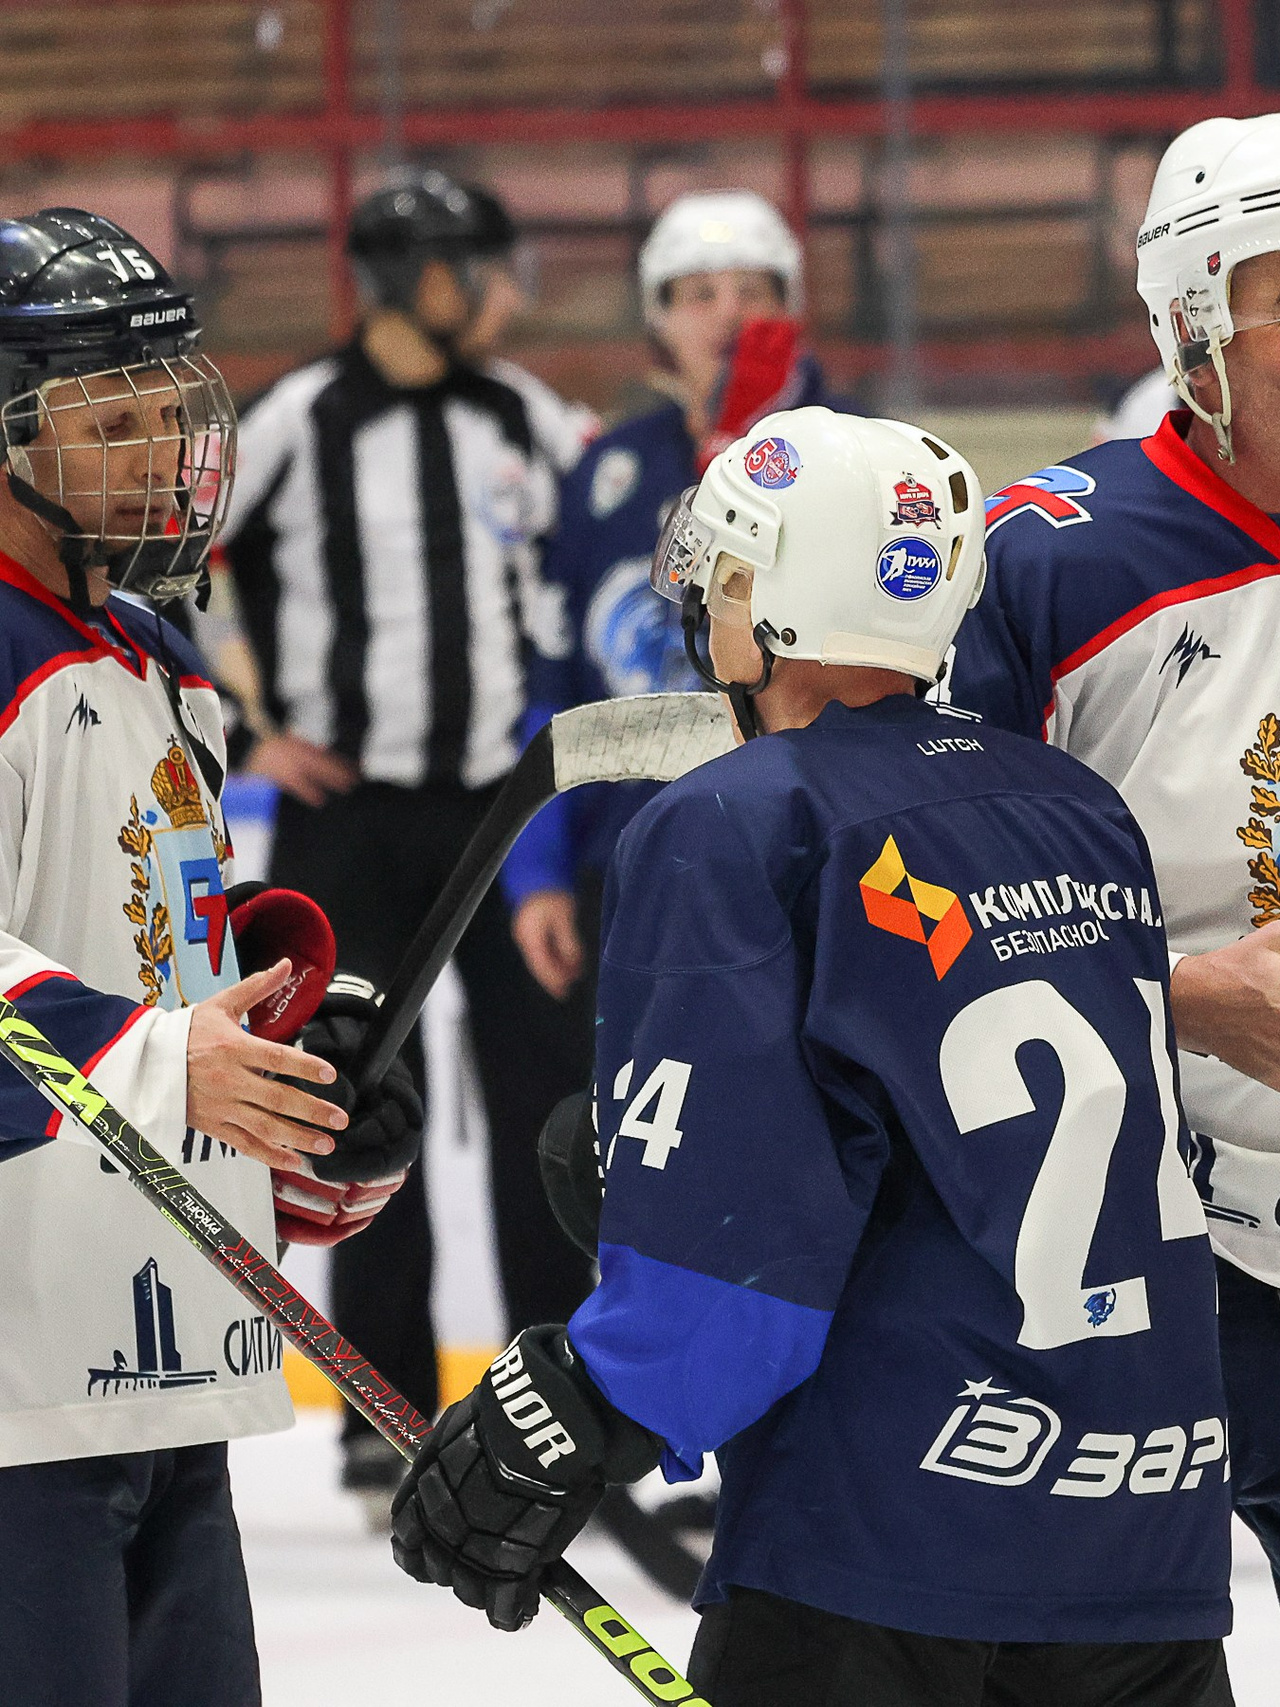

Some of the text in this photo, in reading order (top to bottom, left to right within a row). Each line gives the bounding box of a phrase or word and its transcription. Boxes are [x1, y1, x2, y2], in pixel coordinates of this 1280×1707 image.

[1138, 222, 1171, 248] BAUER
[96, 248, 155, 283] 75
[130, 307, 186, 328] BAUER
[916, 738, 985, 756] LUTCH
[183, 1192, 222, 1236] PYROFIL
[490, 1332, 577, 1469] RIOR
